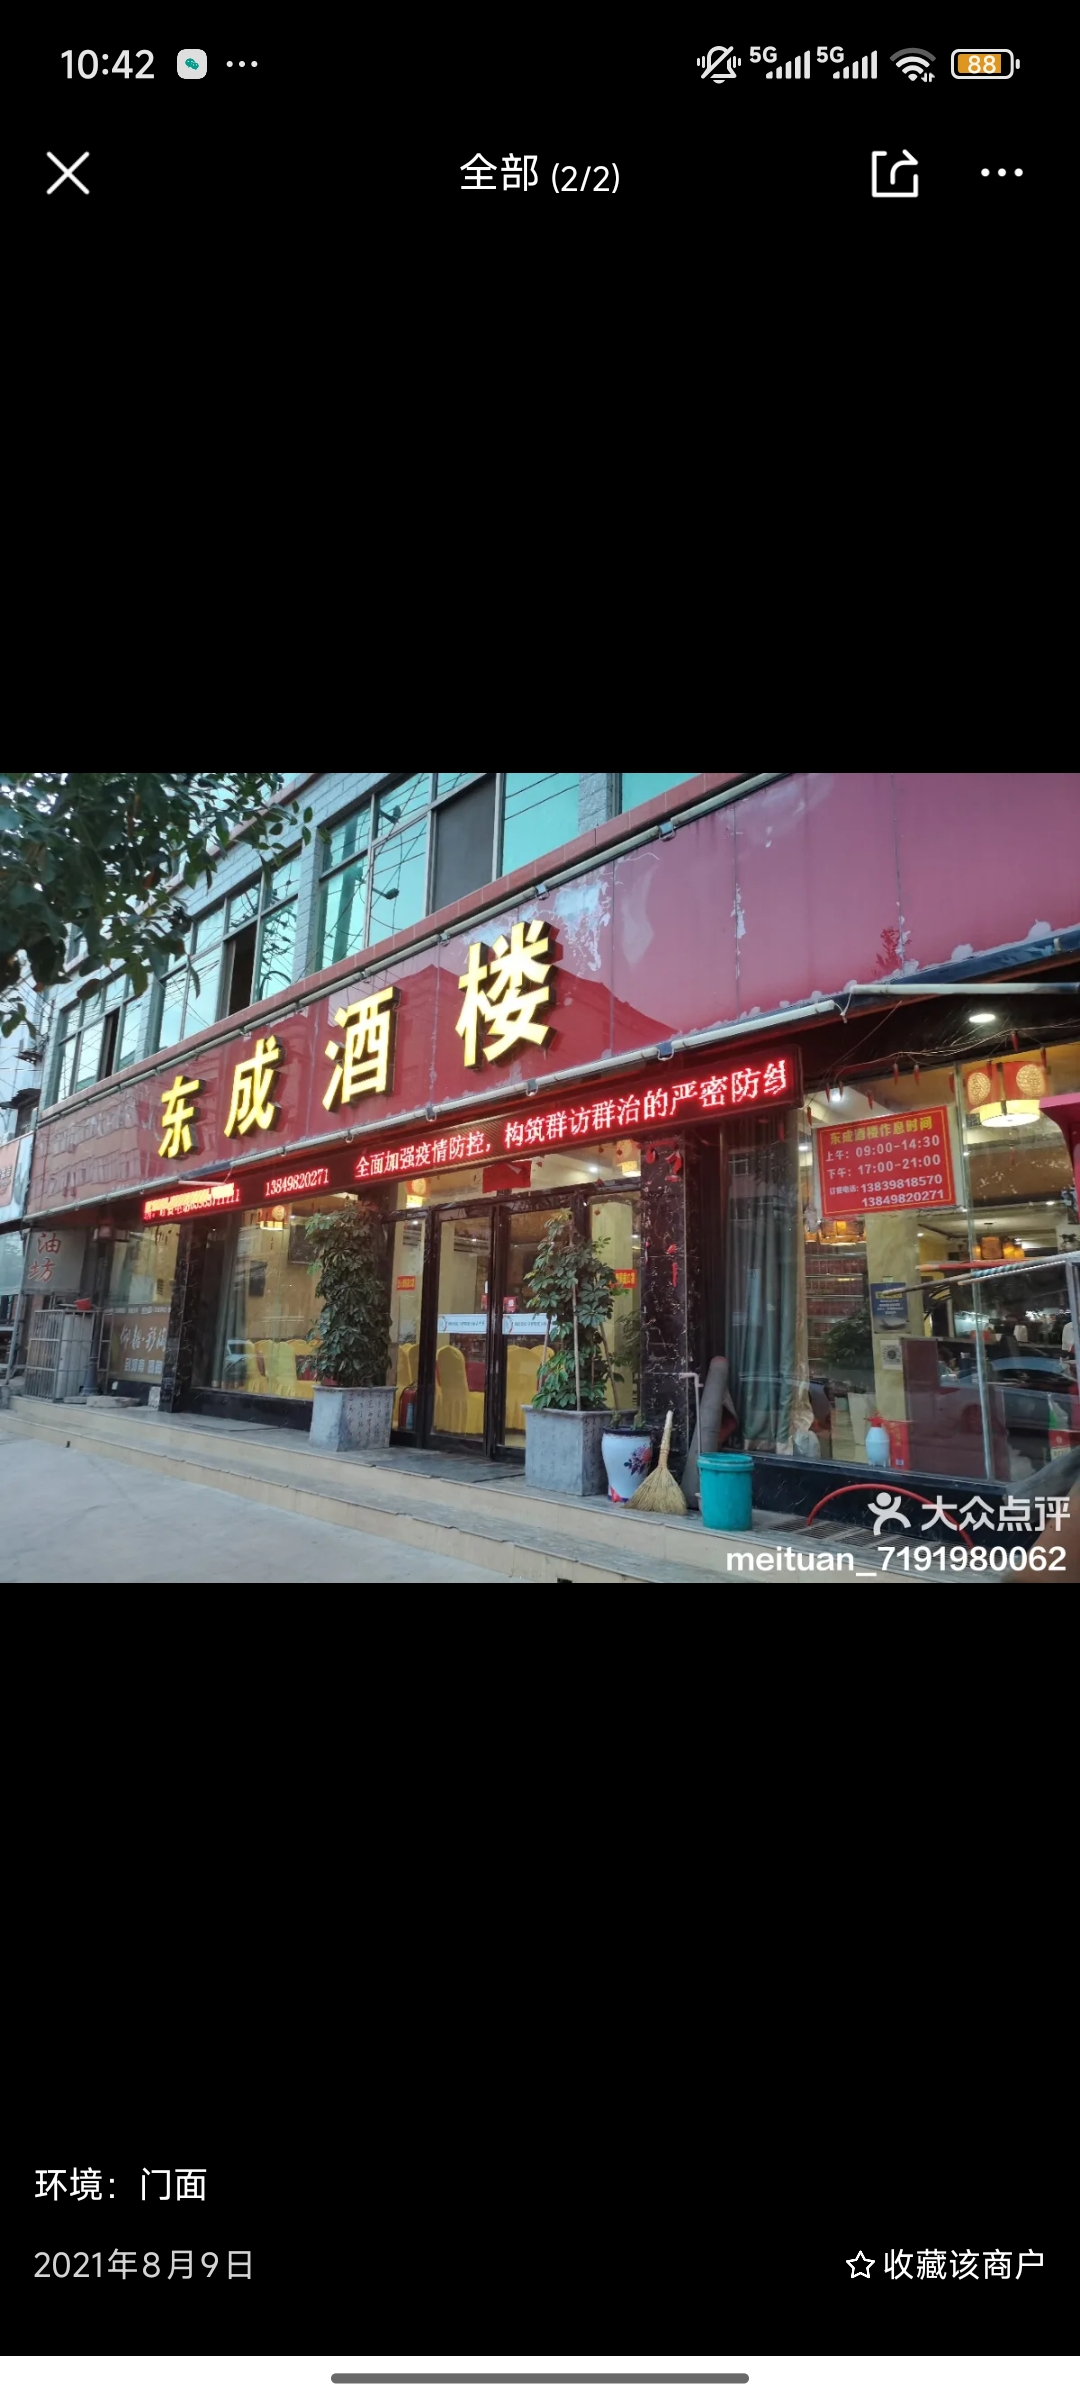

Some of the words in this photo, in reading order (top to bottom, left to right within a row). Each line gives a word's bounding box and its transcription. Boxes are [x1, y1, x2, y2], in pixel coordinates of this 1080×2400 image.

[158, 919, 554, 1158] 东成酒楼
[830, 1116, 933, 1146] 东成酒楼作息时间
[264, 1168, 329, 1197] 13849820271
[861, 1189, 944, 1208] 13849820271
[28, 1232, 62, 1283] 油坊
